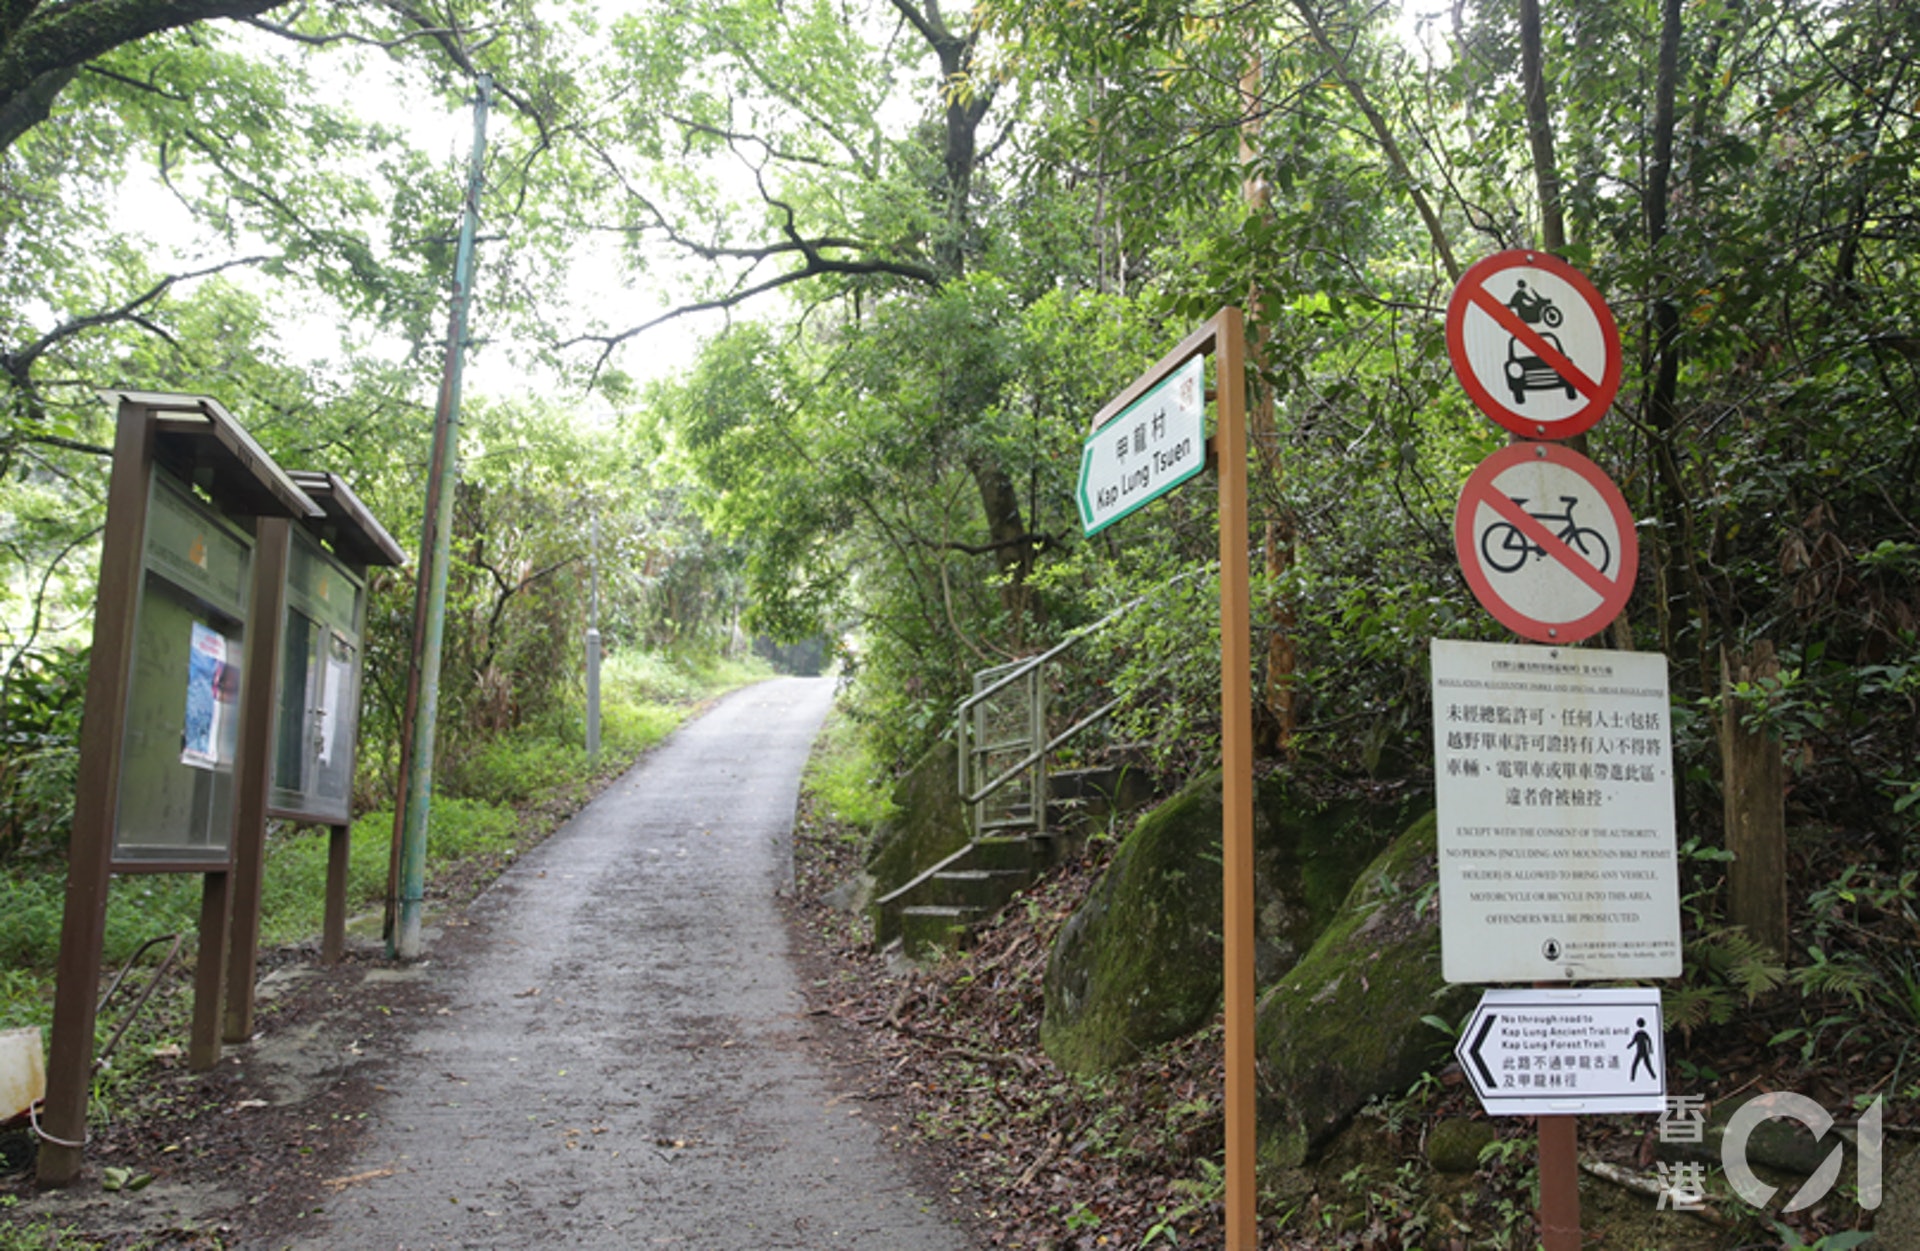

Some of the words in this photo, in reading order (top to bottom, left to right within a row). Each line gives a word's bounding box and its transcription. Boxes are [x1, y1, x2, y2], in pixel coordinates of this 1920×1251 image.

[1116, 407, 1166, 464] 甲龍村
[1097, 485, 1118, 511] Kap
[1122, 465, 1149, 495] Lung
[1153, 438, 1190, 474] Tsuen
[1457, 827, 1490, 837] EXCEPT
[1494, 827, 1516, 837] WITH
[1519, 827, 1534, 837] THE
[1537, 827, 1575, 838] CONSENT
[1579, 828, 1589, 838] OF
[1592, 828, 1607, 838] THE
[1446, 848, 1461, 857] NO
[1462, 848, 1497, 858] PERSON
[1553, 849, 1569, 858] ANY
[1572, 849, 1617, 858] MOUNTAIN
[1620, 849, 1638, 859] BIKE
[1641, 849, 1671, 859] PERMIT
[1503, 870, 1512, 880] IS
[1515, 870, 1557, 880] ALLOWED
[1559, 870, 1570, 880] TO
[1572, 870, 1599, 880] BRING
[1601, 871, 1618, 880] ANY
[1470, 892, 1530, 901] MOTORCYCLE
[1532, 892, 1544, 901] OR
[1546, 892, 1583, 901] BICYCLE
[1586, 892, 1606, 901] INTO
[1608, 891, 1626, 901] THIS
[1485, 914, 1541, 924] OFFENDERS
[1542, 914, 1564, 923] WILL
[1566, 914, 1577, 923] BE
[1501, 1014, 1516, 1023] No
[1517, 1014, 1556, 1025] through
[1560, 1014, 1581, 1024] road
[1584, 1014, 1593, 1023] to
[1501, 1028, 1520, 1038] Kap
[1523, 1028, 1547, 1038] Lung
[1550, 1026, 1587, 1036] Ancient
[1589, 1026, 1610, 1035] Trail
[1612, 1026, 1630, 1035] and
[1501, 1041, 1520, 1050] Kap
[1523, 1040, 1547, 1051] Lung
[1550, 1039, 1581, 1049] Forest
[1584, 1039, 1606, 1048] Trail
[1503, 1073, 1577, 1088] 及甲龍林徑
